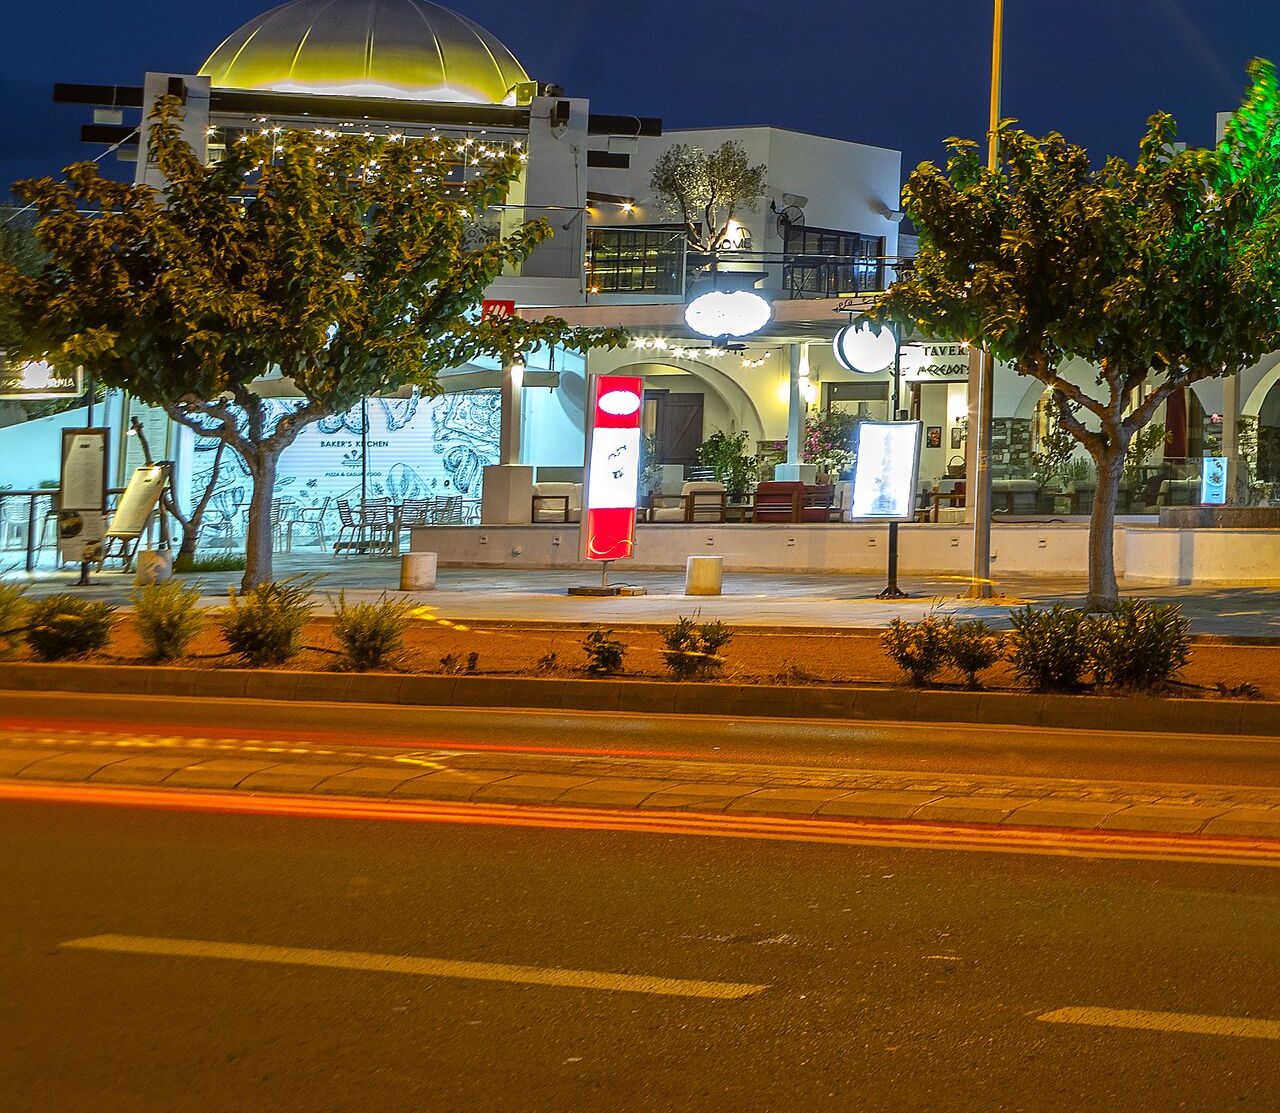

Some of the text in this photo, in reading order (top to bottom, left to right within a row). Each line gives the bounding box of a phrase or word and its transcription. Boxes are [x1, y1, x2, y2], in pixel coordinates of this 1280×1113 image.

[922, 345, 969, 357] TAVER
[320, 440, 389, 448] BAKER'S KICHEN
